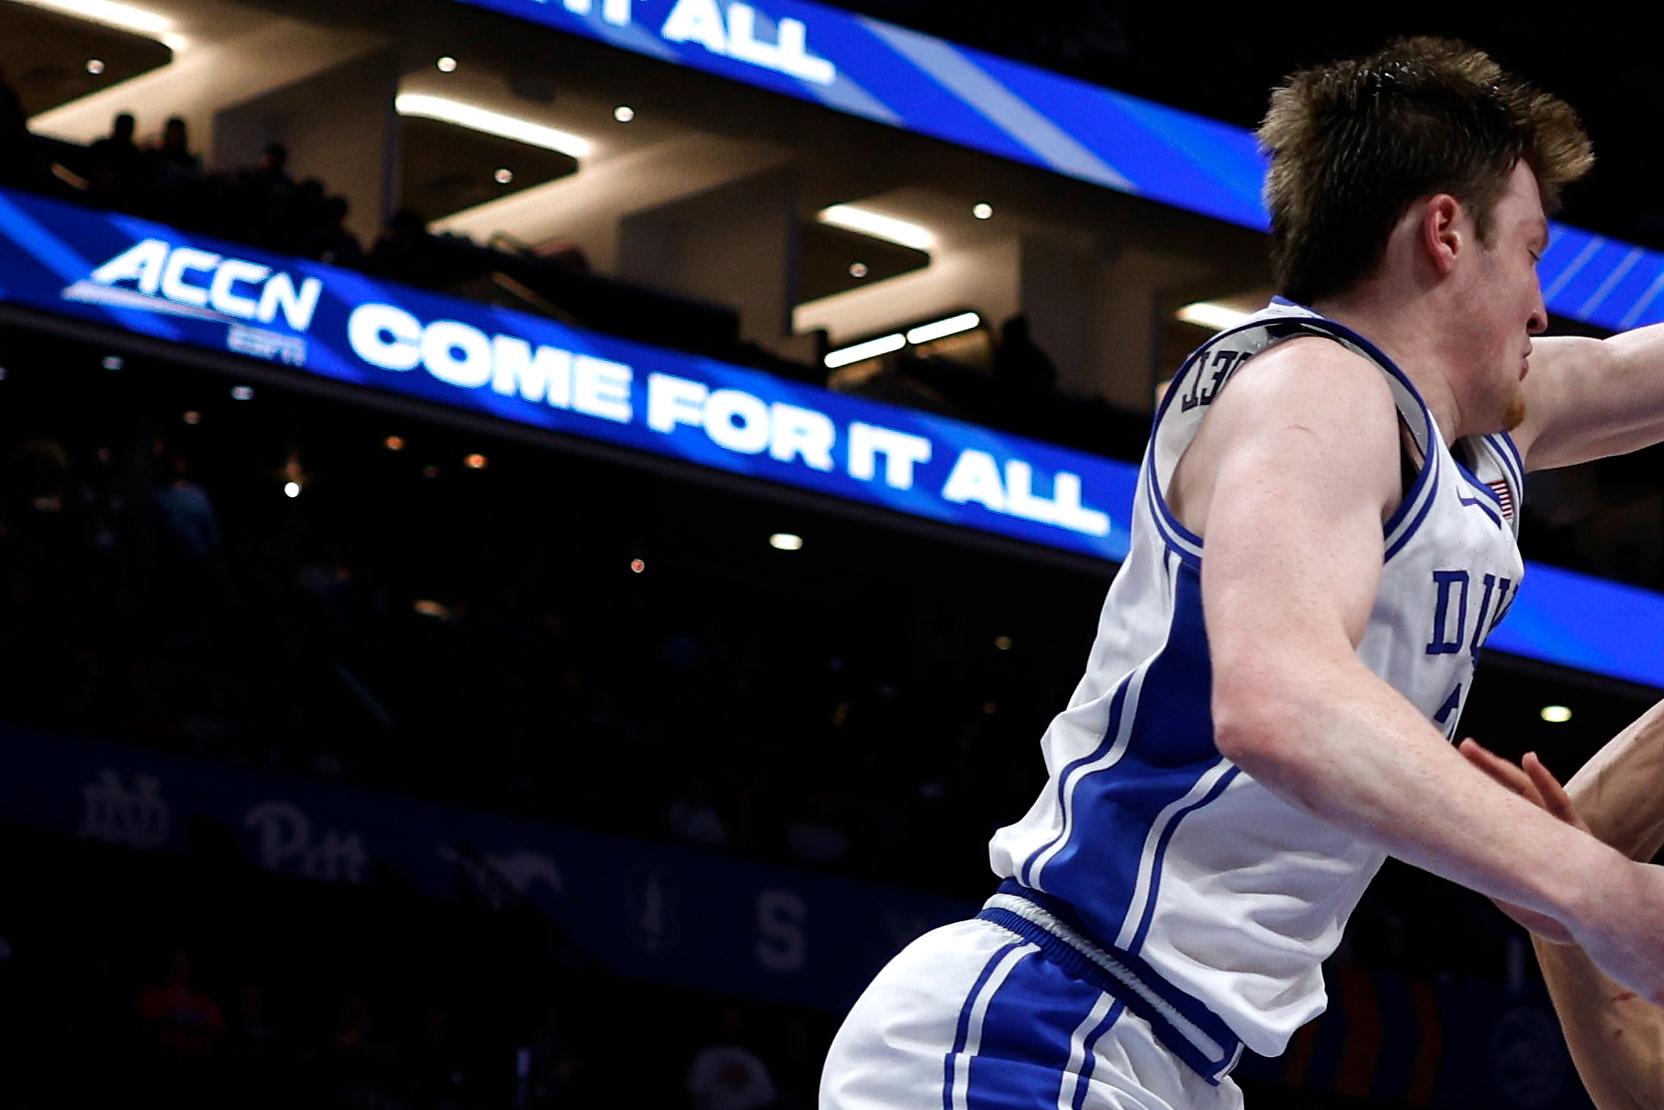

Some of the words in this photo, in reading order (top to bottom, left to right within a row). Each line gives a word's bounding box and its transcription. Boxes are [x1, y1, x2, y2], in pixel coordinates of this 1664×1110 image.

[661, 0, 836, 86] ALL
[91, 238, 322, 331] ACCN
[348, 302, 633, 424] COME
[646, 371, 836, 472] FOR
[847, 421, 932, 490] IT
[942, 449, 1111, 537] ALL
[1426, 570, 1519, 660] DU
